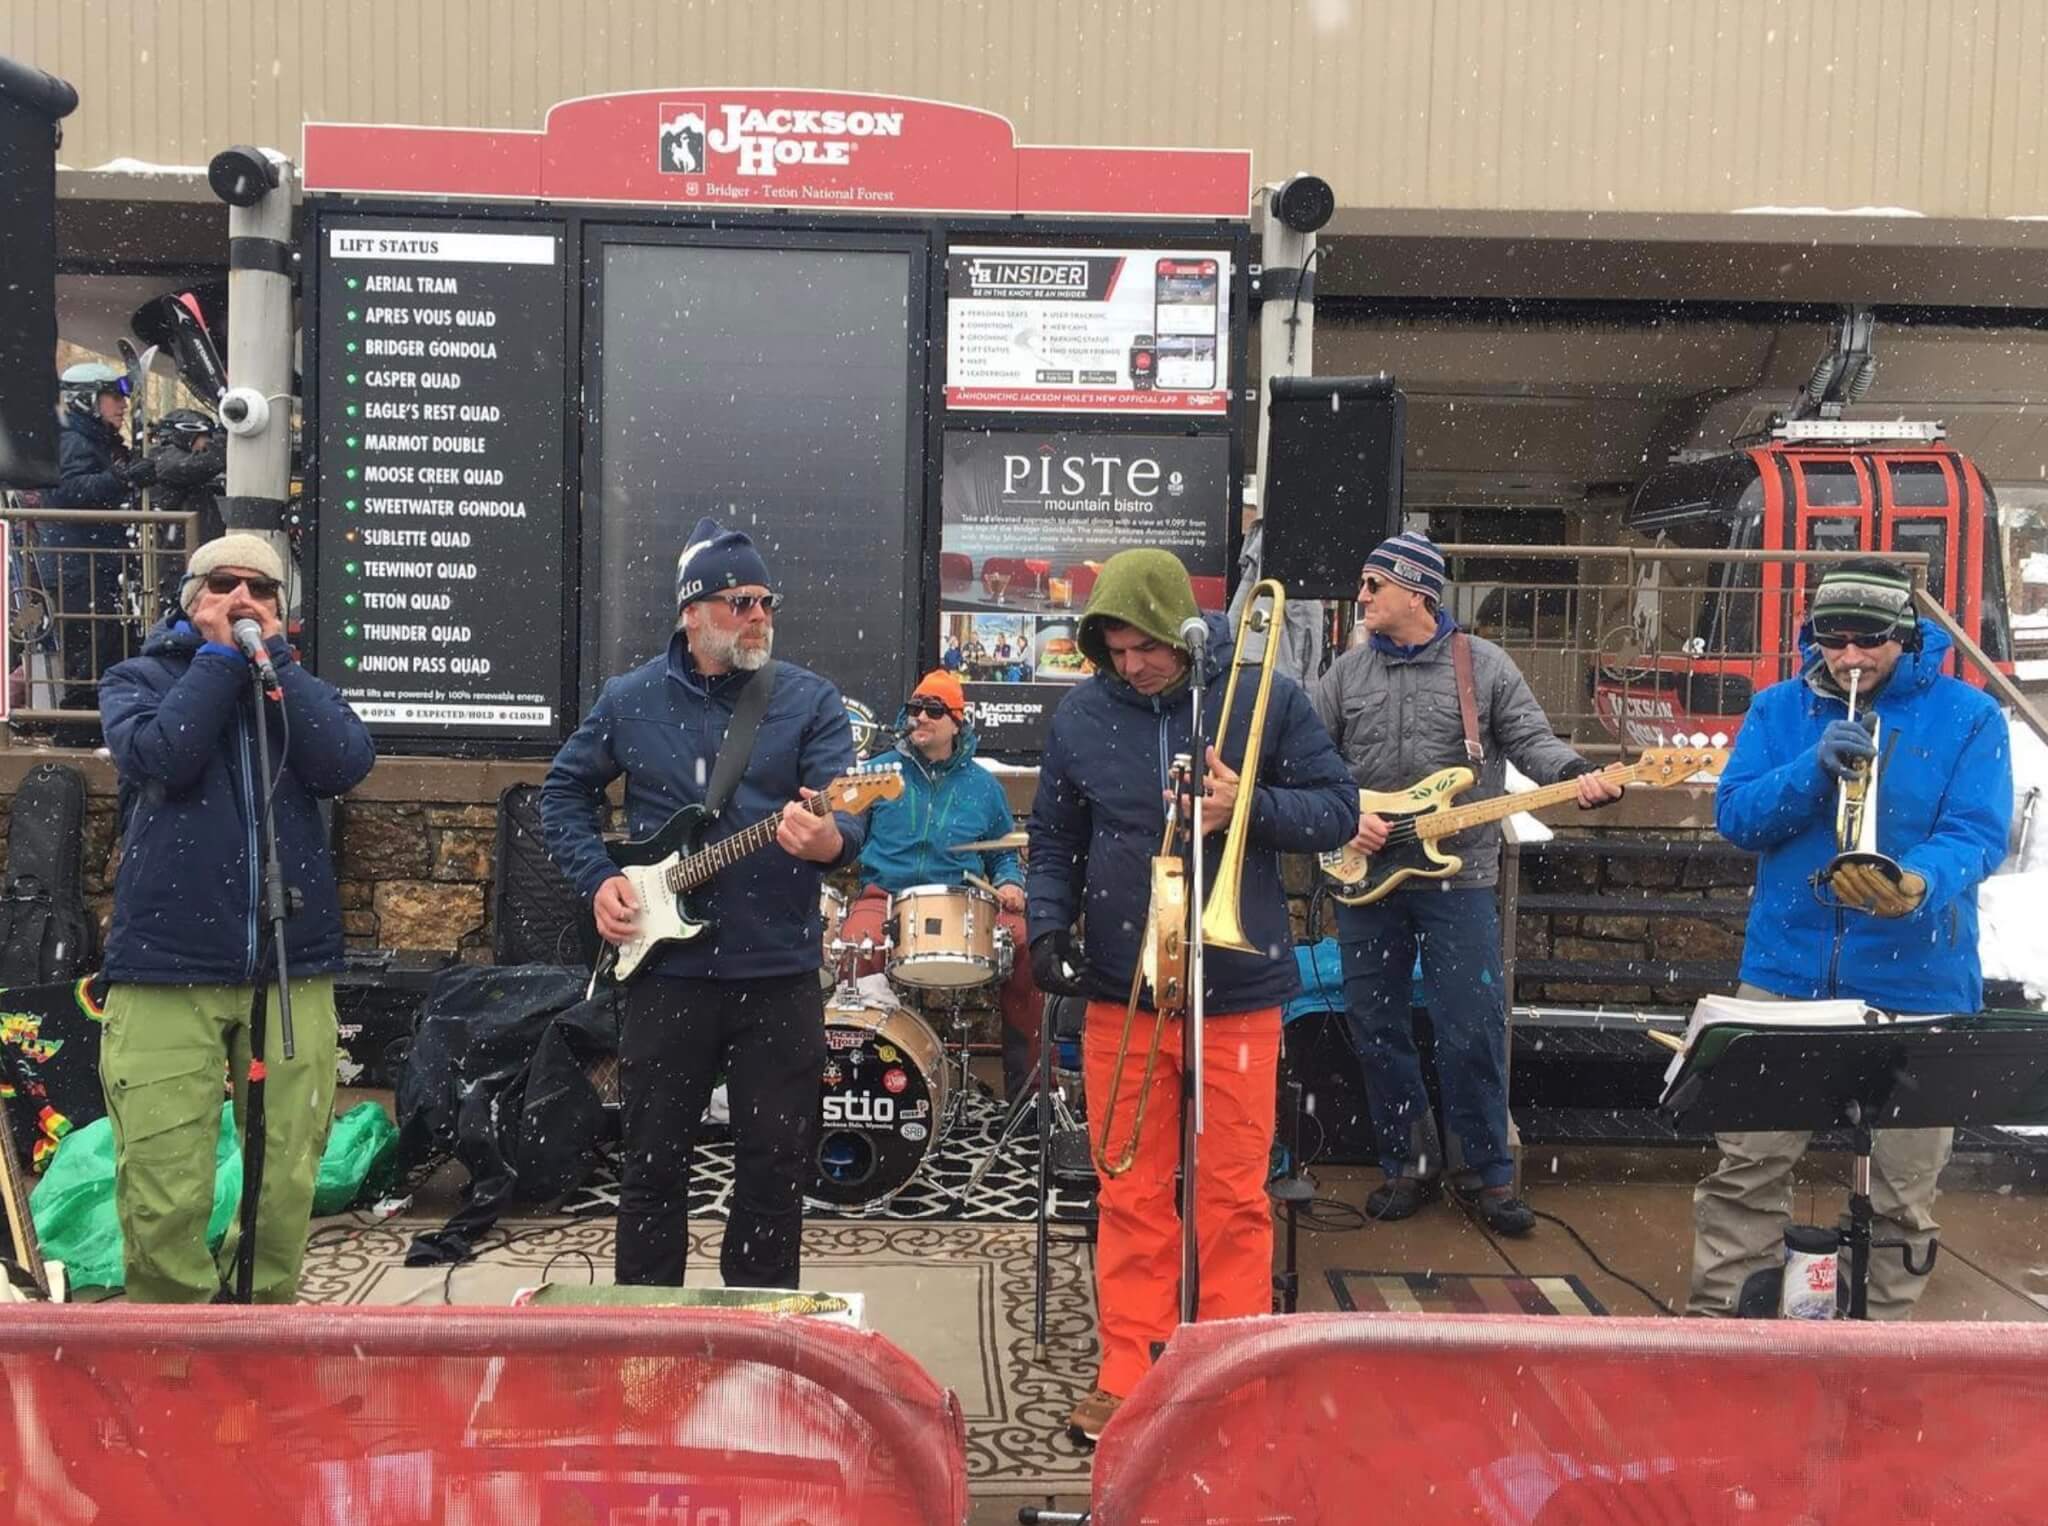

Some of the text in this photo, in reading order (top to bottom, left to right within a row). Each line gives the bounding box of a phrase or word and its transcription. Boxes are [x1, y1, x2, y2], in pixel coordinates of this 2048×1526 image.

[707, 104, 904, 153] JACKSON
[737, 136, 849, 176] HOLE
[706, 183, 750, 198] Bridger
[762, 184, 798, 198] Teton
[802, 185, 854, 200] National
[857, 187, 895, 201] Forest
[339, 238, 439, 254] LIFT STATUS
[996, 265, 1083, 285] INSIDER
[365, 275, 458, 294] AERIAL TRAM
[973, 289, 982, 297] BE
[983, 289, 992, 297] IN
[993, 289, 1007, 297] THE
[1035, 290, 1044, 298] BE
[1045, 290, 1056, 298] AN
[365, 307, 496, 327] APRES VOUS QUAD
[1071, 312, 1108, 320] TRACKING
[365, 339, 497, 359] BRIDGER GONDOLA
[984, 346, 1010, 354] STATUS
[365, 371, 461, 390] CASPER QUAD
[956, 391, 1018, 401] ANNOUNCING
[1020, 392, 1061, 402] JACKSON
[1095, 394, 1118, 403] NEW
[1119, 395, 1158, 404] OFFICIAL
[1159, 395, 1179, 404] APP
[365, 402, 500, 422] EAGLE'S REST QUAD
[365, 434, 486, 454] MARMOT DOUBLE
[365, 466, 504, 486] MOOSE CREEK QUAD
[364, 497, 527, 518] SWEETWATER GONDOLA
[1044, 499, 1154, 513] mountain bistro
[961, 514, 978, 523] Take
[990, 515, 1022, 524] elevated
[1023, 516, 1056, 527] approach
[1068, 517, 1089, 525] casual
[1090, 517, 1114, 527] dining
[1115, 518, 1131, 526] with
[1138, 519, 1155, 527] view
[1189, 519, 1206, 527] from
[364, 529, 471, 548] SUBLETTE QUAD
[1003, 533, 1037, 541] Mountain
[1159, 537, 1194, 546] enhanced
[1196, 538, 1206, 547] by
[1115, 527, 1144, 535] features
[1145, 528, 1180, 536] American
[1181, 528, 1206, 536] cuisine
[364, 561, 477, 580] TEEWINOT QUAD
[363, 592, 451, 611] TETON QUAD
[363, 624, 471, 643] THUNDER QUAD
[362, 655, 491, 675] UNION PASS QUAD
[383, 690, 396, 698] are
[398, 689, 433, 700] powered
[435, 689, 446, 701] by
[448, 690, 471, 700] 100%
[472, 690, 515, 701] renewable
[371, 708, 545, 720] OPEN EXPECTED/HOLD CLOSED
[976, 702, 1042, 719] JACKSON
[985, 714, 1024, 727] HOLE
[826, 1030, 875, 1046] JACKSON
[833, 1039, 860, 1050] HOLE
[823, 1090, 894, 1122] stio
[865, 1122, 894, 1130] Wyoming
